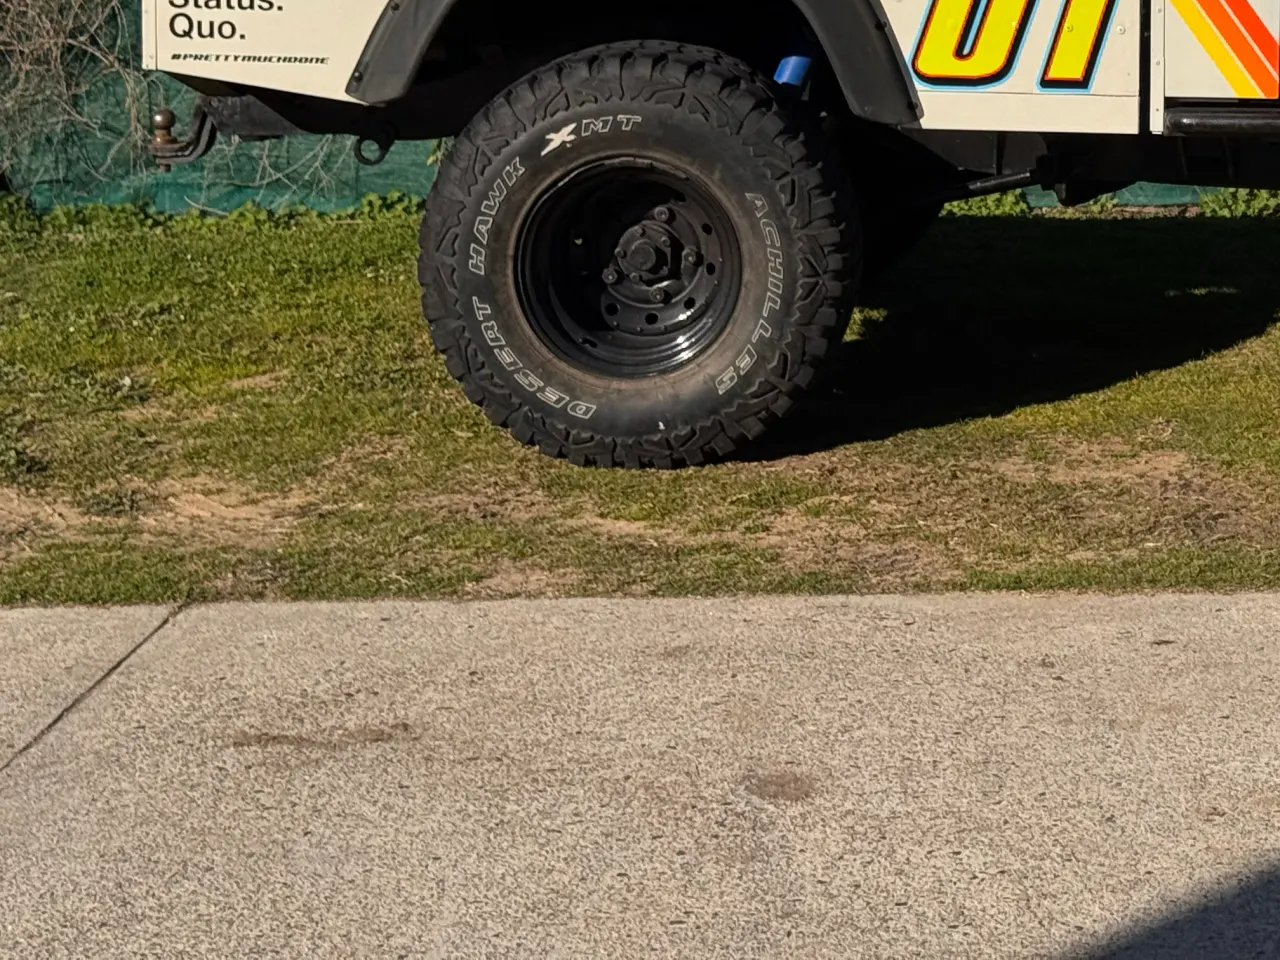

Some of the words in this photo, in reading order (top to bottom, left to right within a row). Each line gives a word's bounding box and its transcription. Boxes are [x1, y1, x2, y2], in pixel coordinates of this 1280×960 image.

[169, 13, 246, 40] Quo.
[468, 156, 525, 276] HAWK
[714, 192, 786, 396] ACHILLES
[472, 295, 598, 420] DESERT
